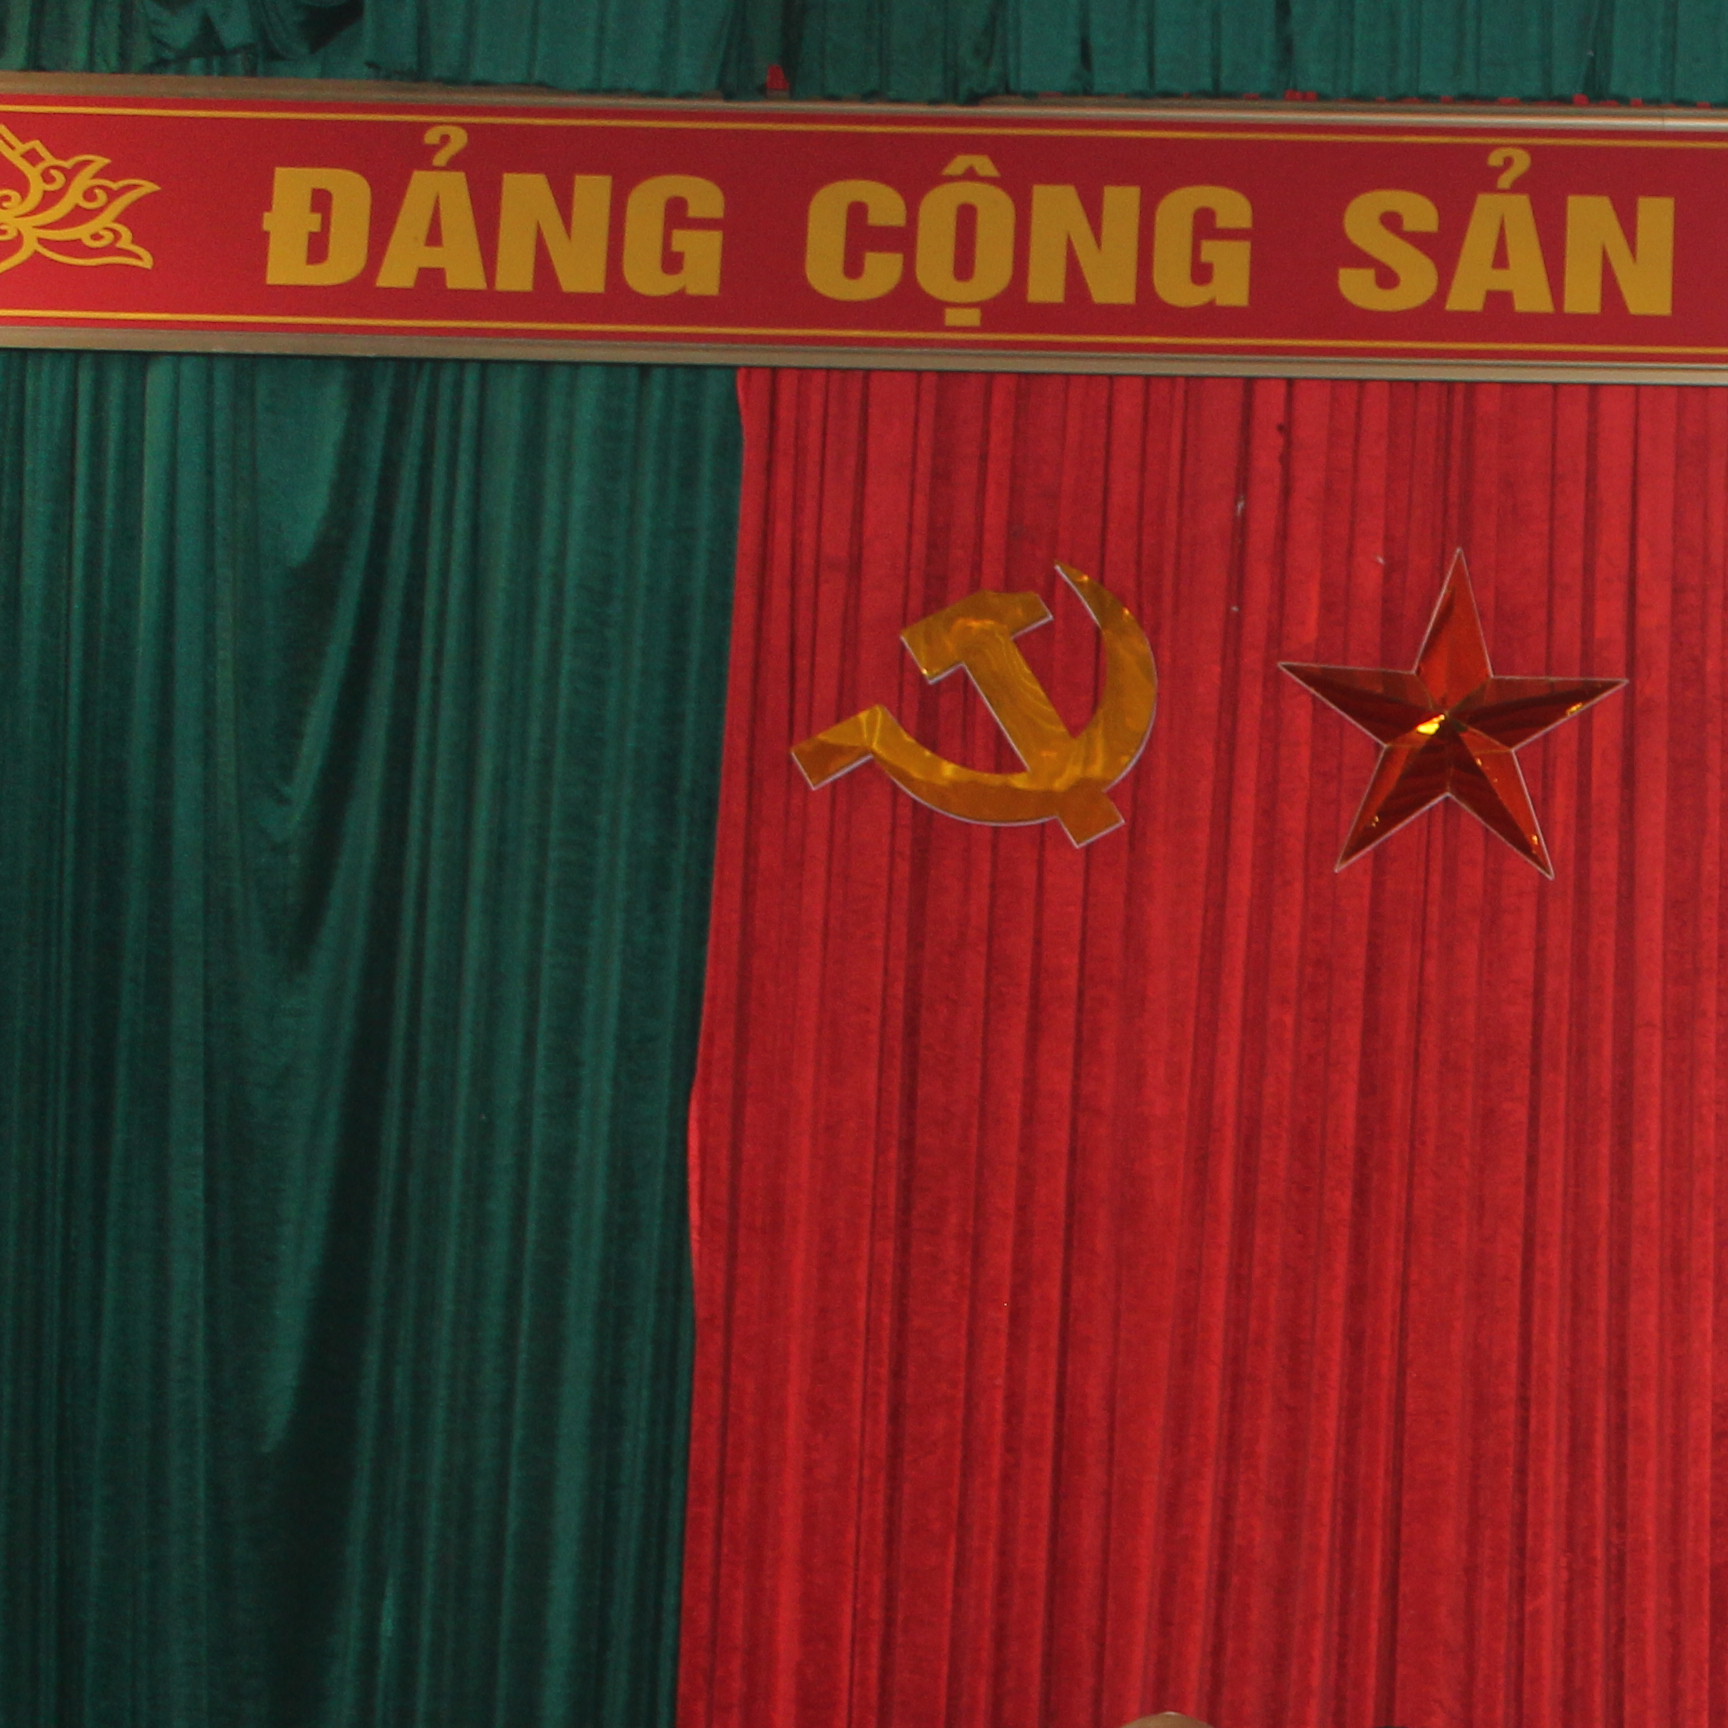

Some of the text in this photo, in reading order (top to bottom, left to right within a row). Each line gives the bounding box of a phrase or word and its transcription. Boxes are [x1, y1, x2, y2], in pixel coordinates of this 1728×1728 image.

[264, 126, 723, 296] ĐẢNG
[808, 156, 1251, 326] CỘNG
[1339, 148, 1674, 315] SẢN
